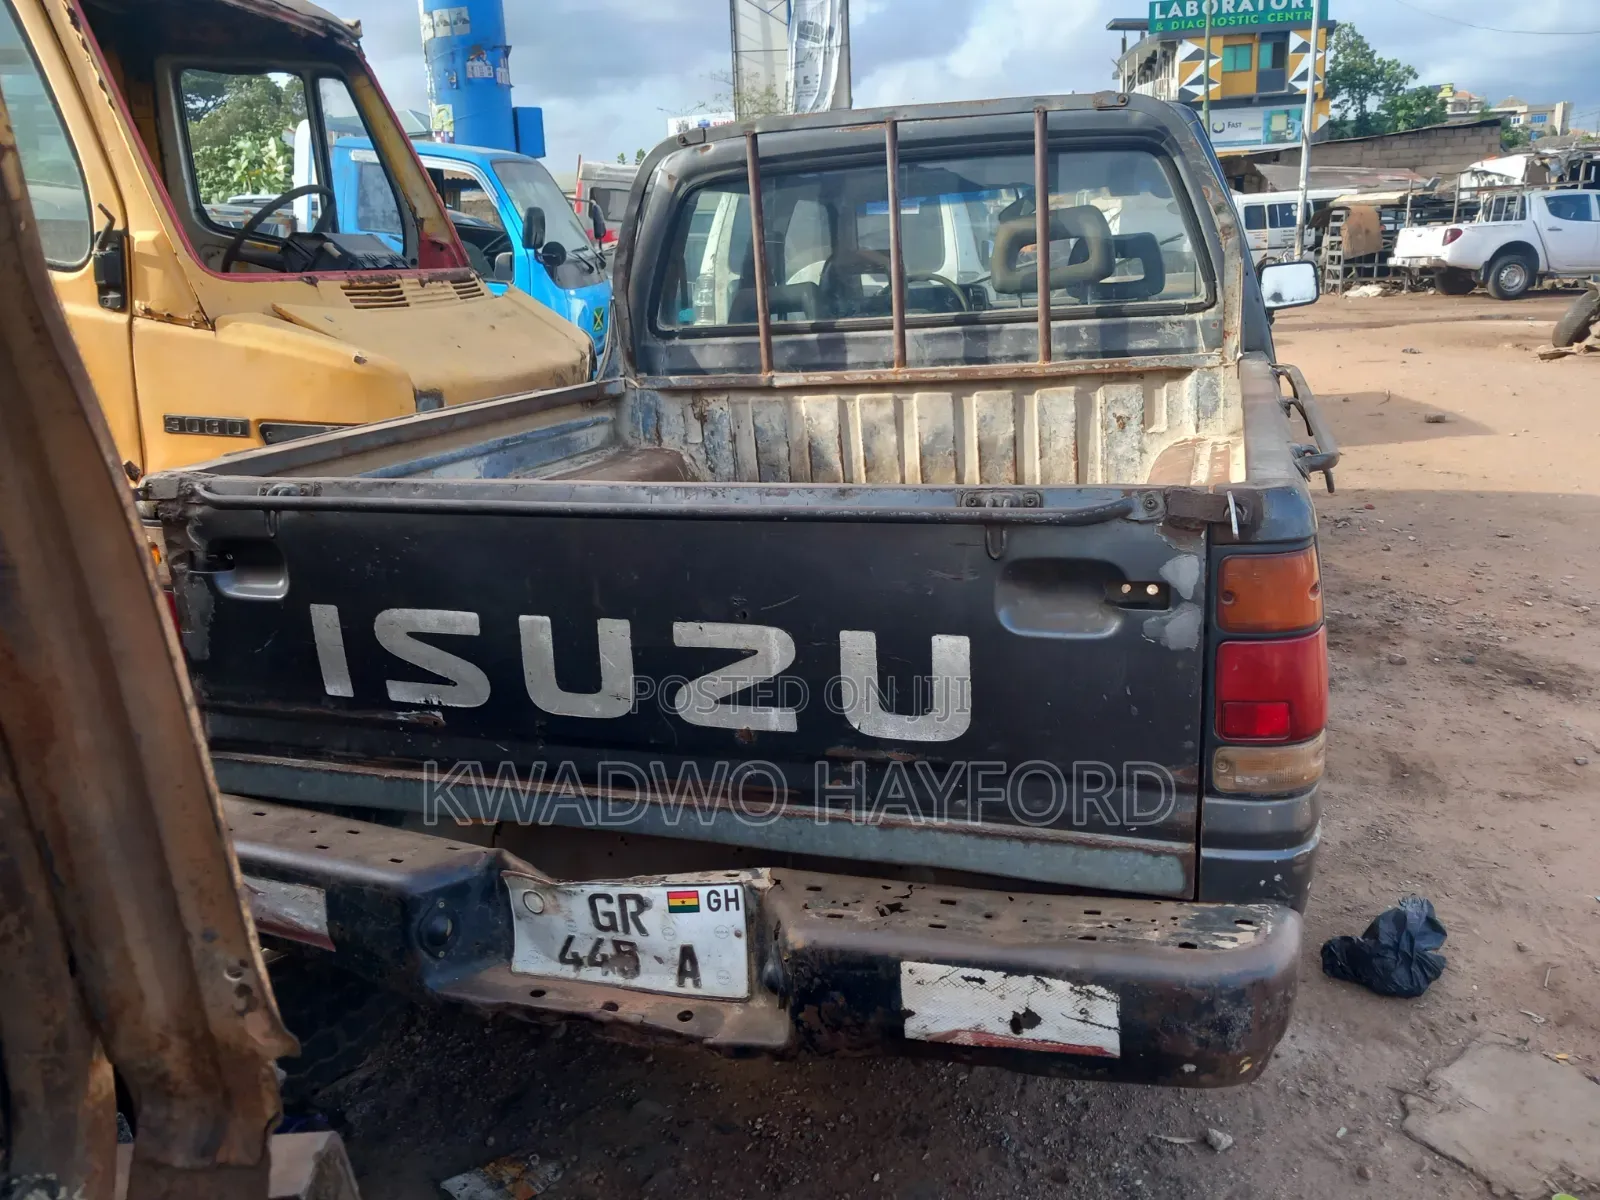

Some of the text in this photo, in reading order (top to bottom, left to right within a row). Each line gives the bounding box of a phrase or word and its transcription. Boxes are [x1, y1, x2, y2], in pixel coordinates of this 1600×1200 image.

[1155, 0, 1315, 19] LABORATOR
[1267, 11, 1313, 22] CENTR
[310, 603, 972, 742] ISUZU
[588, 893, 649, 936] GR
[706, 889, 740, 912] GH
[676, 944, 702, 988] A
